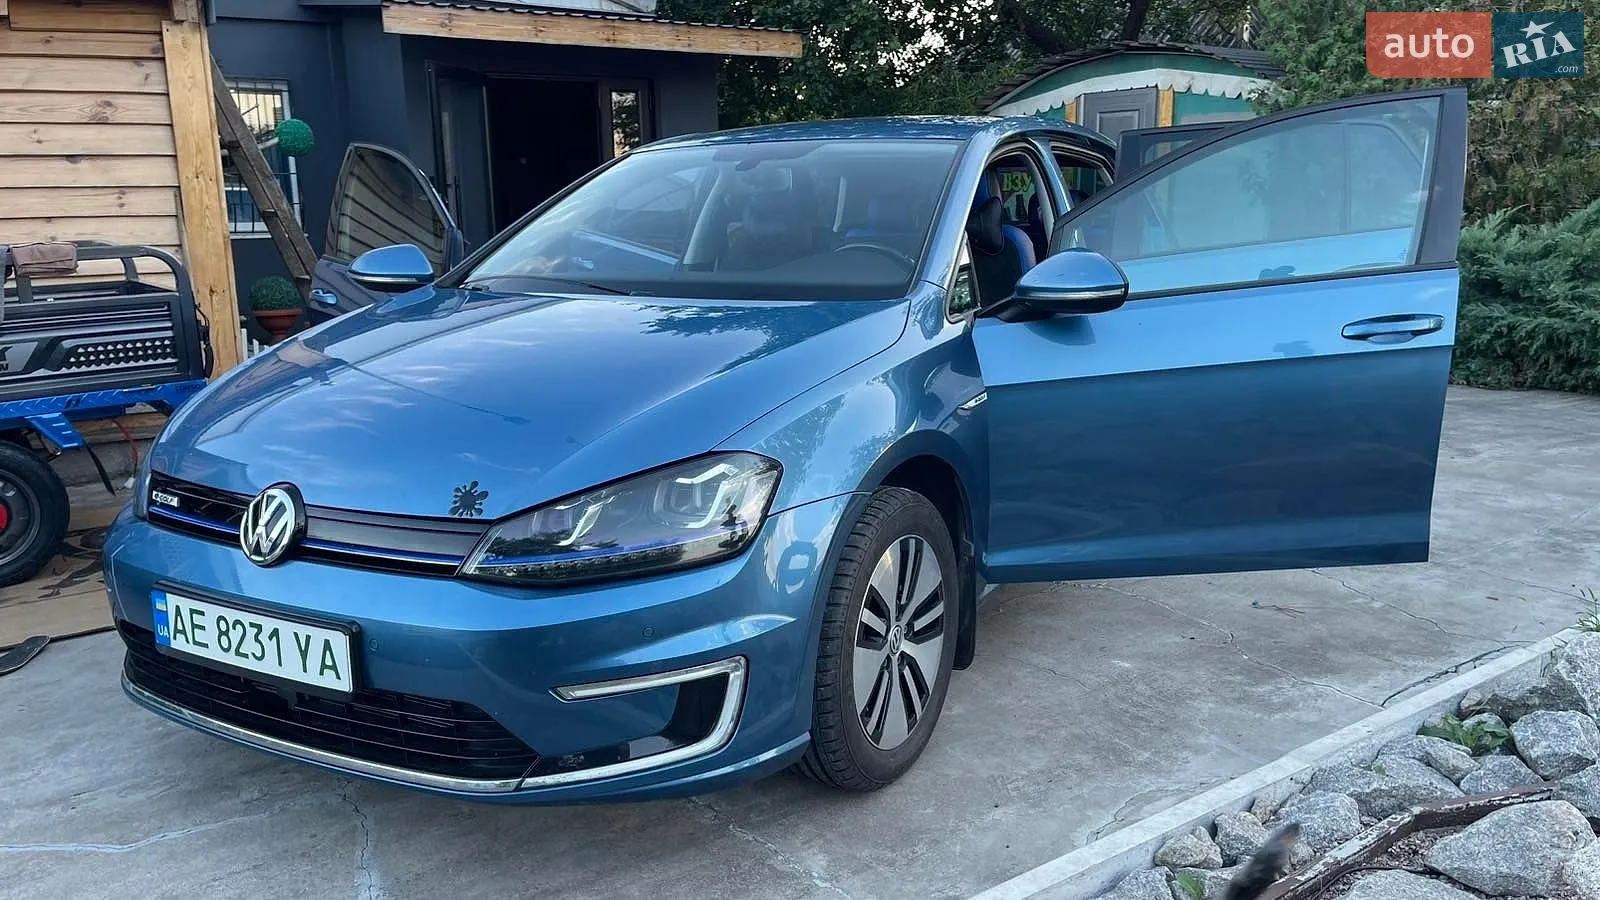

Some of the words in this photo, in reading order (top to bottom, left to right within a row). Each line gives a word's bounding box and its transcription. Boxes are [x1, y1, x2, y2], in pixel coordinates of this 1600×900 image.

[158, 624, 170, 637] UA
[172, 604, 209, 649] AE
[216, 615, 283, 667] 8231
[293, 631, 342, 681] YA
